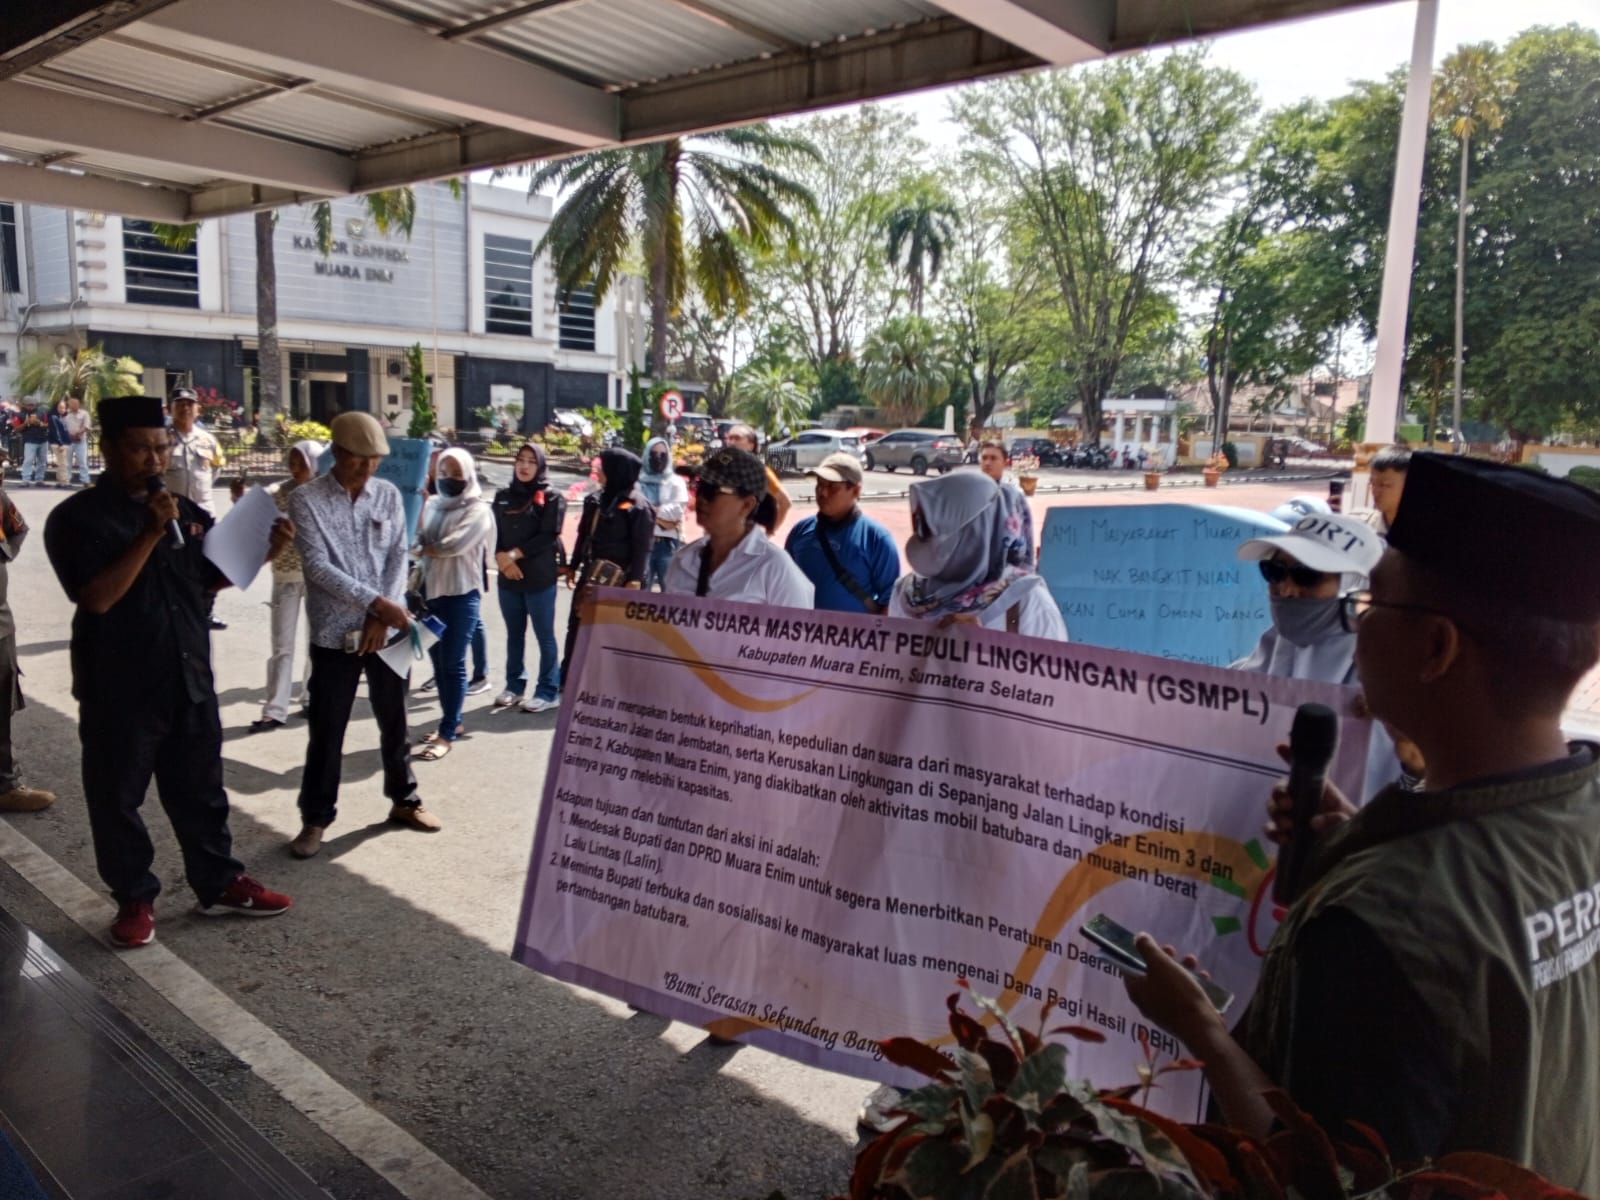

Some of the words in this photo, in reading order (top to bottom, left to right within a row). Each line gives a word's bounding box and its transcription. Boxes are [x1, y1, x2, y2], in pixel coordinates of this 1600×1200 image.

[293, 236, 348, 255] KAOR
[314, 261, 360, 279] MUARA
[1296, 517, 1364, 552] ORT
[1093, 568, 1120, 584] NAK
[1128, 567, 1193, 585] BANGKIT
[1197, 569, 1240, 585] NIAN
[1059, 602, 1096, 618] UKAN
[1215, 605, 1266, 623] DOANG
[625, 601, 702, 629] GERAKAN
[704, 611, 760, 637] SUARA
[764, 617, 891, 653] MASYARAKAT
[895, 632, 971, 664] PEDULI
[977, 642, 1138, 695] LINGKUNGAN
[1147, 672, 1271, 726] (GSMPL)
[737, 644, 807, 669] Kabupaten
[809, 654, 854, 674] Muara
[858, 661, 904, 684] Enim,
[908, 667, 986, 694] Sumatera
[989, 680, 1055, 708] Selatan
[563, 752, 598, 773] lainnya
[599, 763, 629, 781] yang
[630, 768, 676, 789] melebihi
[676, 775, 734, 803] kapasitas.
[572, 710, 628, 734] Kerusakan
[629, 721, 655, 739] Jalan
[655, 727, 675, 745] dan
[676, 731, 733, 759] Jembatan,
[735, 746, 765, 764] serta
[768, 750, 835, 778] Kerusakan
[838, 763, 914, 796] Lingkungan
[918, 780, 935, 798] di
[938, 782, 1019, 820] Sepanjang
[1022, 802, 1065, 829] Jalan
[1068, 815, 1131, 849] Lingkar
[1135, 834, 1181, 864] Enim
[1185, 848, 1197, 868] 3
[1200, 855, 1234, 881] dan
[576, 691, 599, 706] Aksi
[600, 693, 616, 708] ini
[617, 700, 668, 721] merupakan
[670, 708, 707, 729] bentuk
[708, 714, 775, 744] keprihatian,
[778, 729, 848, 756] kepedulian
[851, 743, 876, 762] dan
[877, 751, 913, 771] suara
[917, 754, 950, 774] dari
[953, 762, 1041, 796] masyarakat
[1044, 782, 1117, 818] terhadap
[1119, 801, 1186, 836] kondisi
[556, 787, 594, 809] Adapun
[595, 799, 629, 818] tujuan
[631, 805, 654, 824] dan
[656, 812, 704, 836] tuntutan
[706, 823, 728, 843] dari
[730, 830, 756, 850] aksi
[758, 836, 774, 854] ini
[775, 844, 822, 868] adalah:
[567, 730, 594, 748] Enim
[605, 738, 662, 764] Kabupaten
[664, 750, 697, 772] Muara
[699, 758, 732, 781] Enim,
[732, 769, 762, 790] yang
[765, 773, 837, 804] diakibatkan
[840, 791, 866, 811] oleh
[867, 798, 929, 823] aktivitas
[934, 809, 978, 832] mobil
[981, 816, 1049, 851] batubara
[1052, 839, 1083, 862] dan
[1086, 851, 1149, 883] muatan
[1153, 867, 1200, 899] berat
[564, 833, 588, 851] Lalu
[588, 840, 622, 862] Lintas
[556, 878, 632, 912] pertambangan
[632, 900, 691, 929] batubara.
[558, 810, 567, 825] 1.
[569, 812, 621, 838] Mendesak
[622, 826, 663, 849] Bupati
[664, 839, 685, 856] dan
[687, 841, 723, 865] DPRD
[724, 851, 762, 876] Muara
[764, 862, 796, 886] Enim
[798, 874, 833, 898] untuk
[834, 886, 881, 911] segera
[885, 896, 985, 930] Menerbitkan
[988, 915, 1063, 957] Peraturan
[560, 854, 604, 880] Meminta
[605, 867, 644, 891] Bupati
[645, 879, 691, 904] terbuka
[692, 892, 715, 912] dan
[717, 900, 783, 932] sosialisasi
[784, 917, 799, 938] ke
[801, 926, 880, 962] masyarakat
[884, 946, 917, 967] luas
[922, 954, 1000, 986] mengenai
[1003, 971, 1043, 1002] Dana
[1046, 987, 1084, 1018] Bagi
[1086, 1002, 1127, 1035] Hasil
[1130, 1021, 1180, 1061] (DBH)
[701, 985, 759, 1018] Serasan
[758, 1000, 840, 1051] Sekundang
[841, 1029, 886, 1062] Bang
